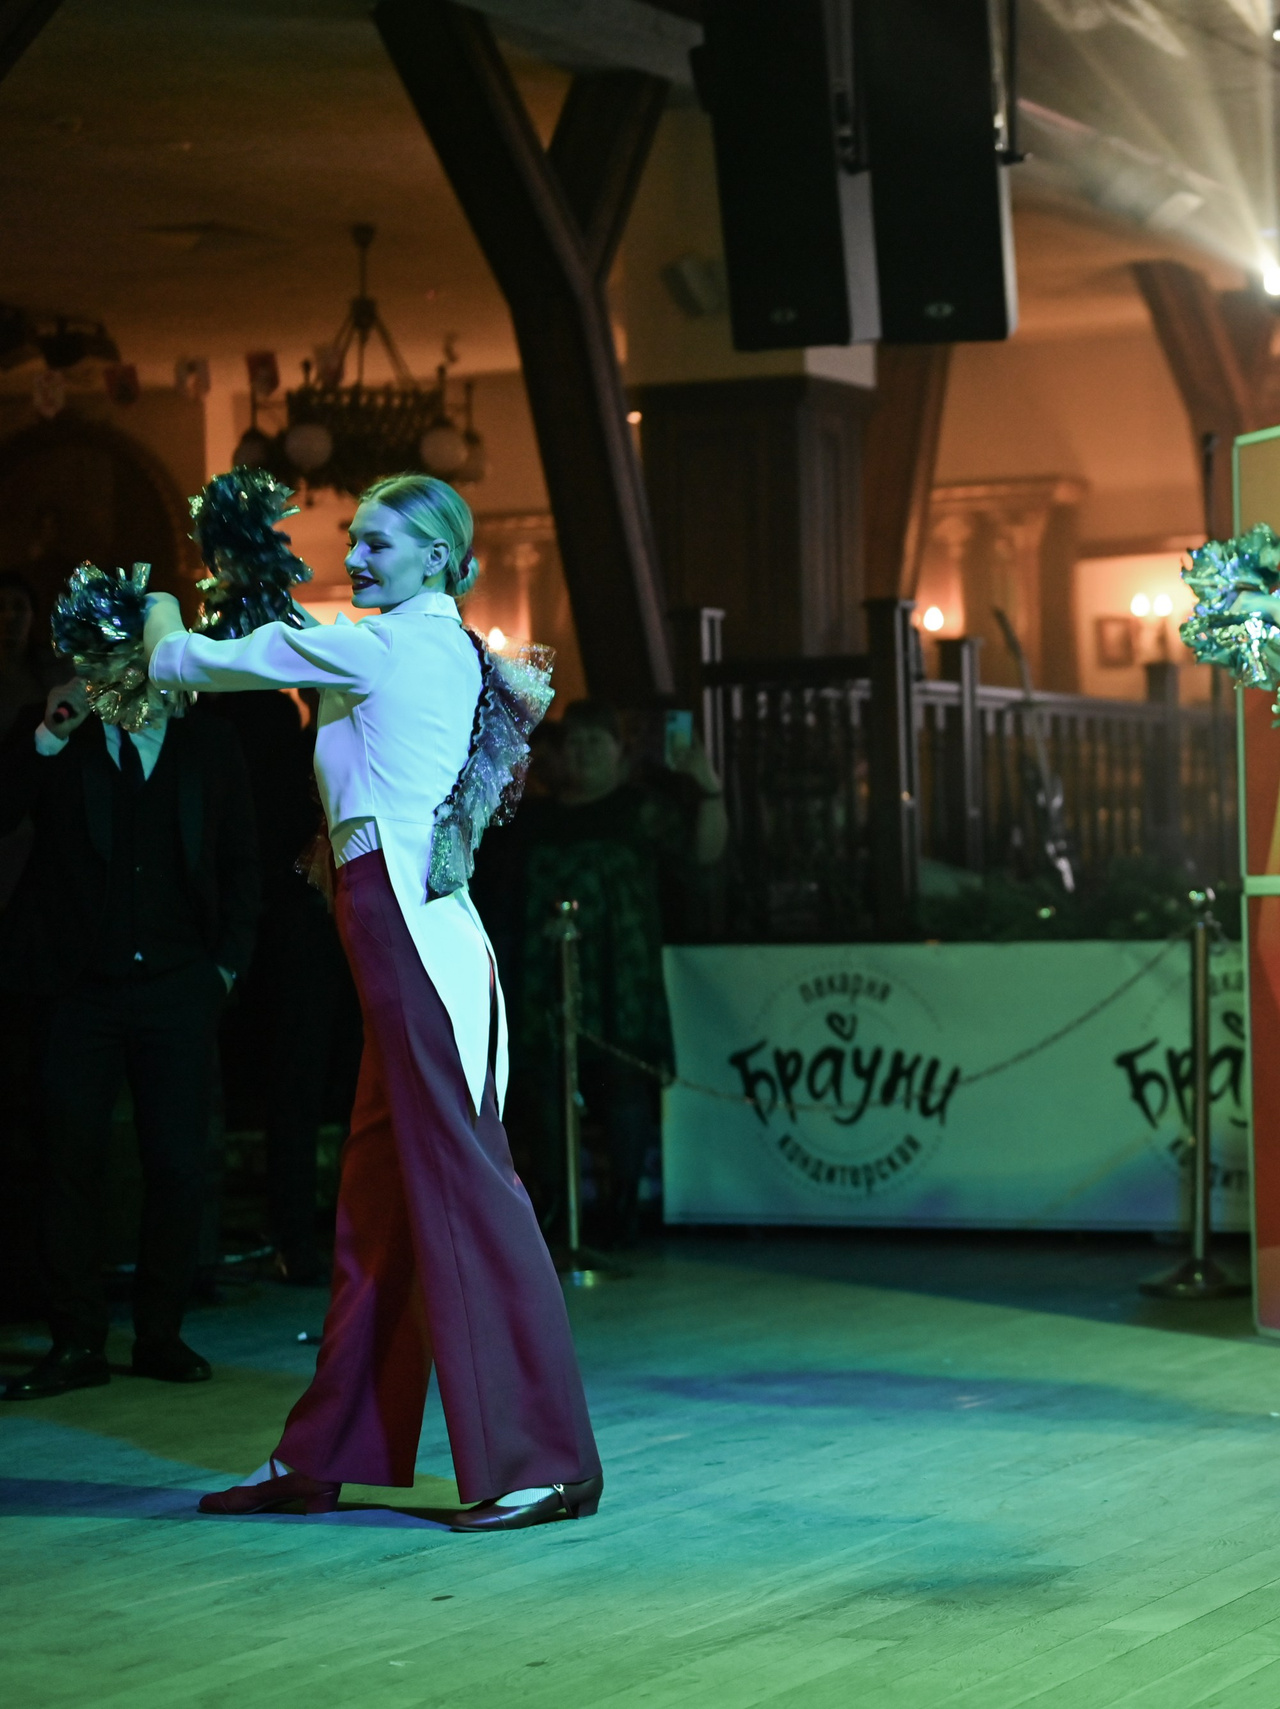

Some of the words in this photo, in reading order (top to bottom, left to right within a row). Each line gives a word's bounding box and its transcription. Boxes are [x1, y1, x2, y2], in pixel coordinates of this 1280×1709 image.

[799, 972, 892, 1004] пекарня
[729, 1039, 961, 1126] Брауни
[778, 1134, 922, 1196] кондитерская
